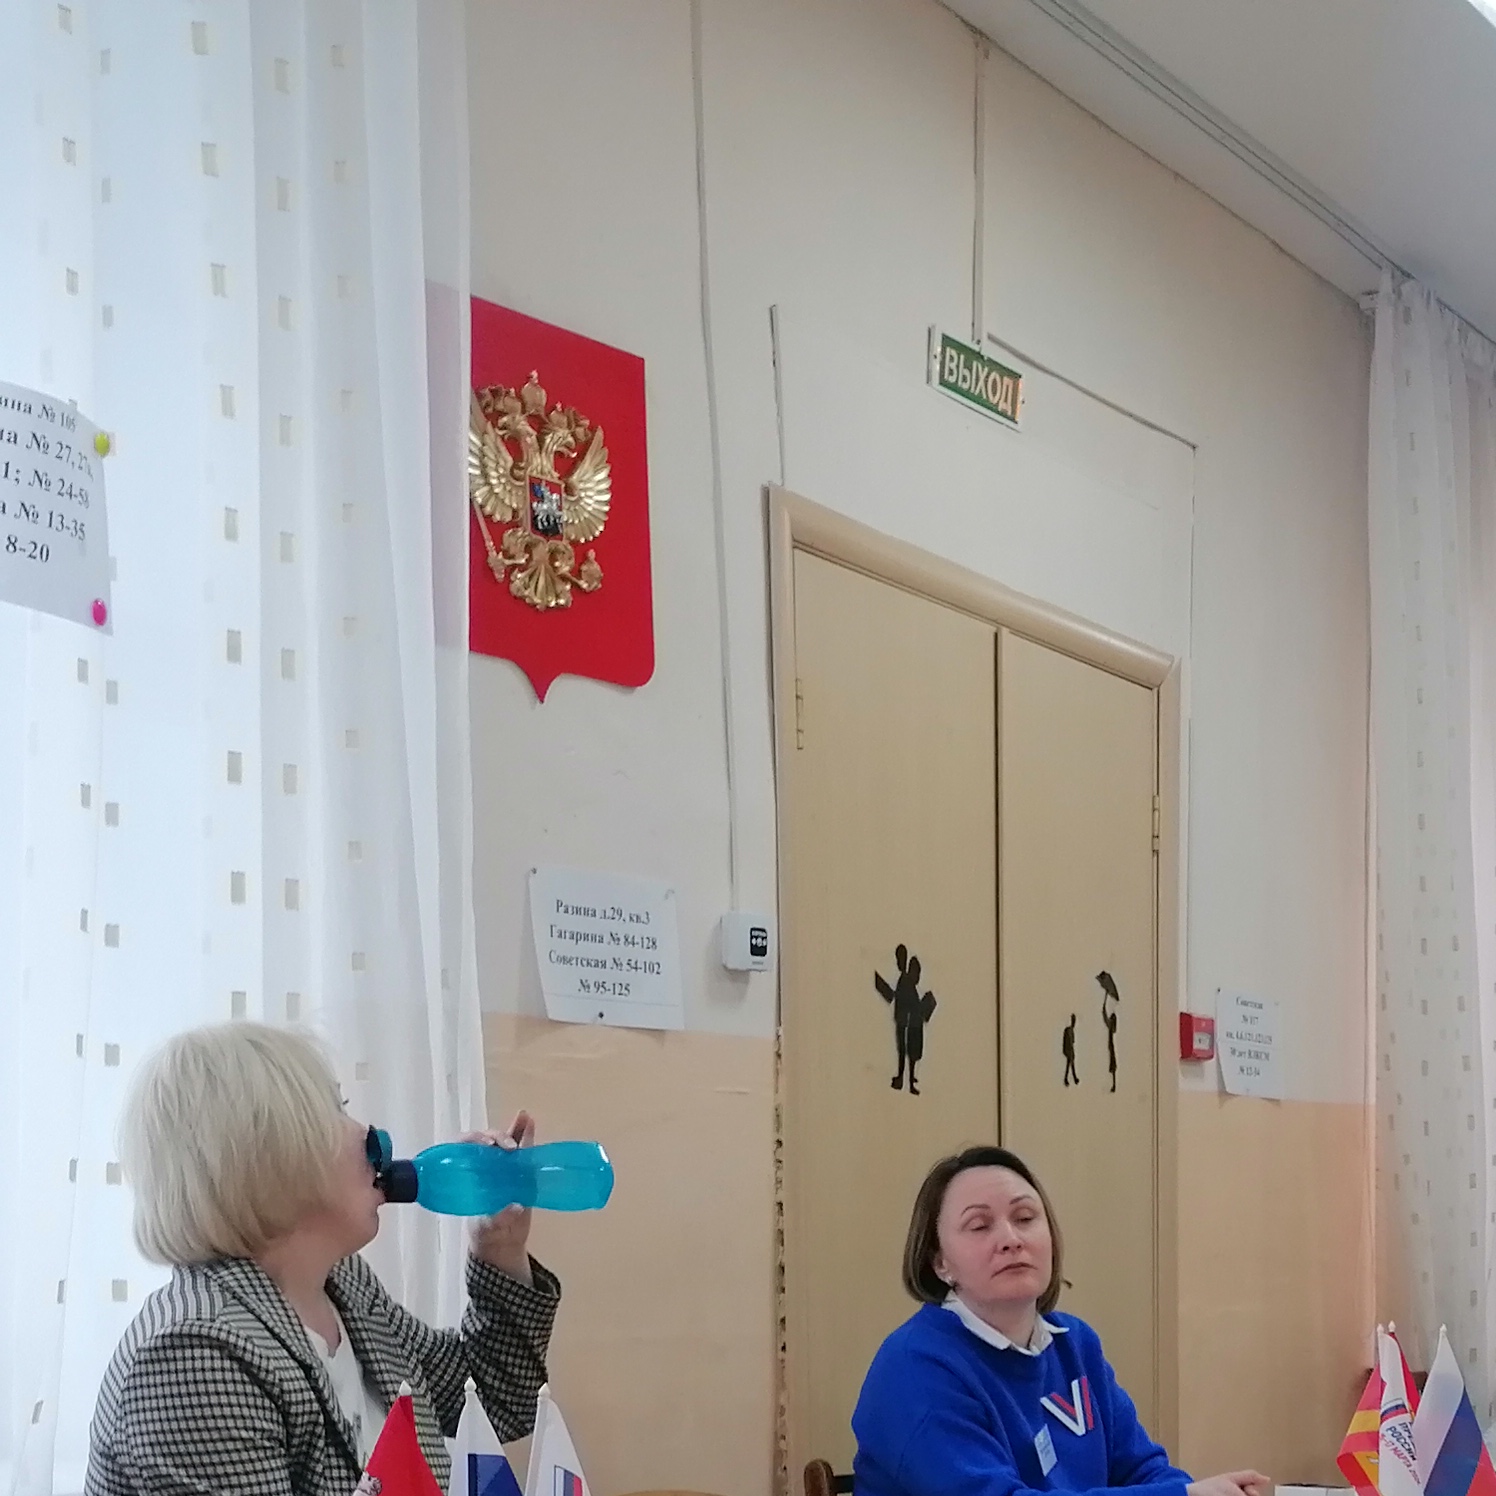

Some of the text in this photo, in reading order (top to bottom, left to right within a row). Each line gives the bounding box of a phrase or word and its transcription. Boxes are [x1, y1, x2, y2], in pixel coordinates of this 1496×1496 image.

[944, 346, 1014, 416] ВЫХОД
[37, 404, 56, 423] №
[25, 431, 50, 455] №
[28, 469, 51, 492] №
[14, 500, 39, 525] №
[556, 899, 597, 918] Разина
[550, 924, 658, 950] Гагарина № 84-128
[548, 949, 661, 975] Советская № 54-102
[578, 979, 631, 996] № 95-125
